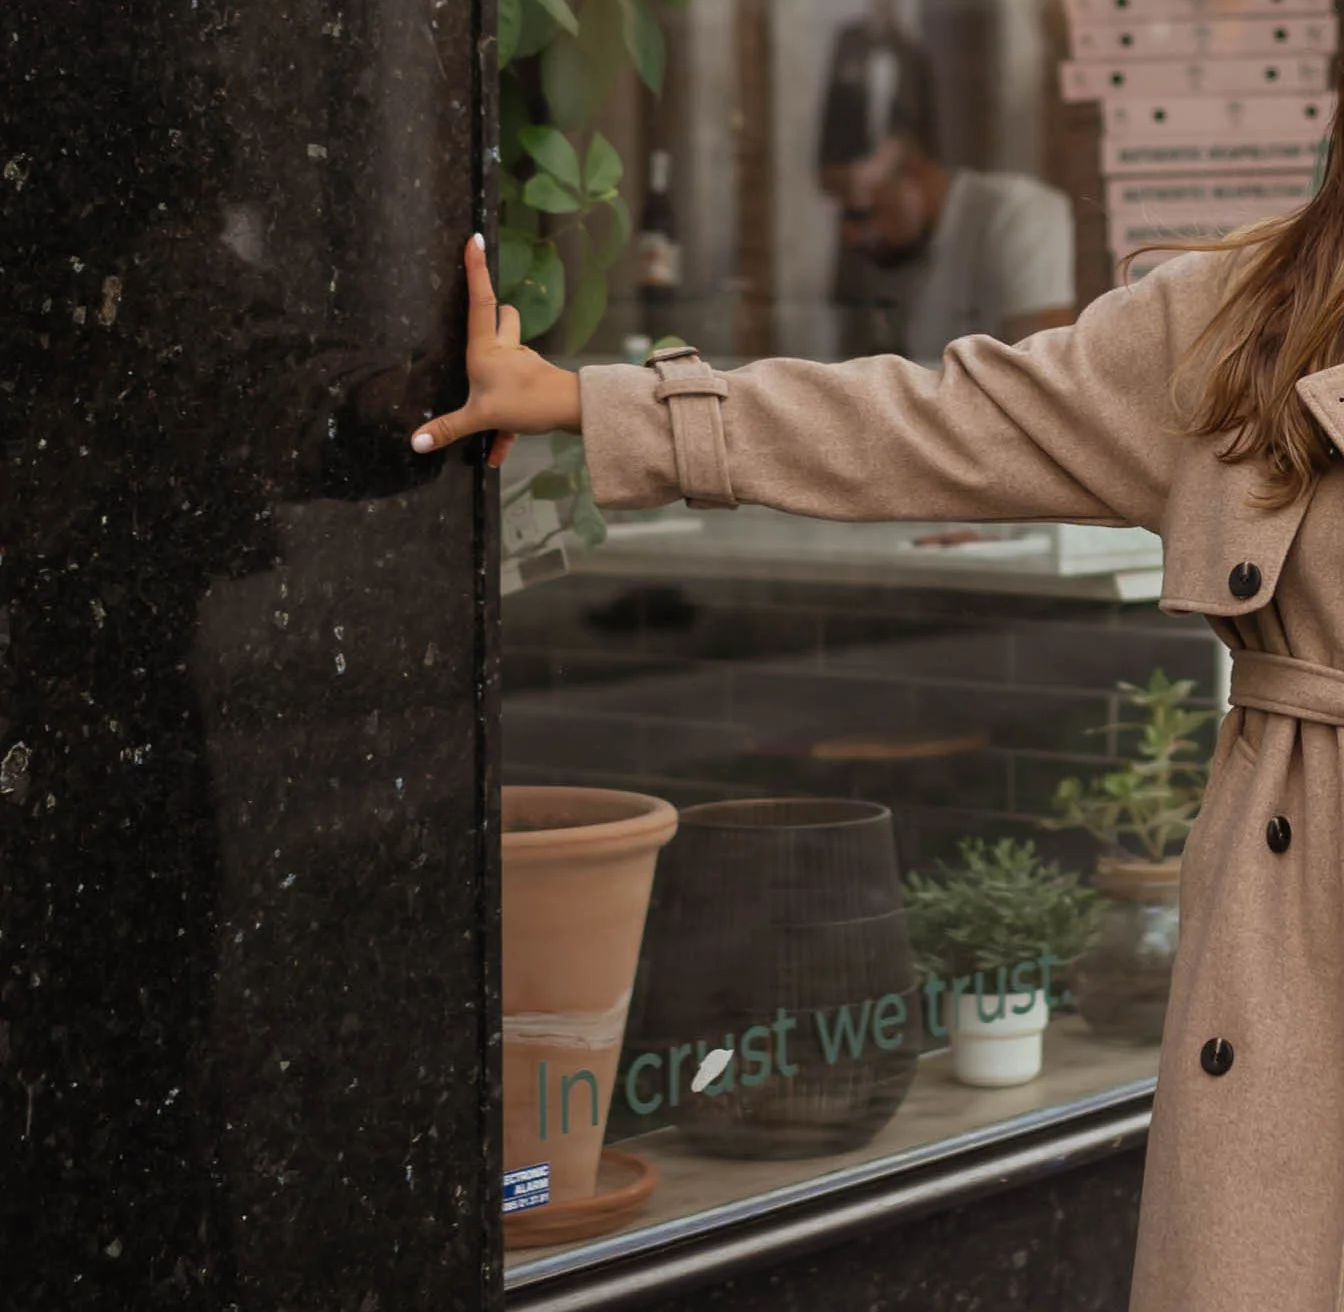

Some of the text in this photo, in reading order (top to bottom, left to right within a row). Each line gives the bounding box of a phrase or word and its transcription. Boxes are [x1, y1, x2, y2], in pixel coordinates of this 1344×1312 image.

[537, 943, 1072, 1141] In crust we trust.
